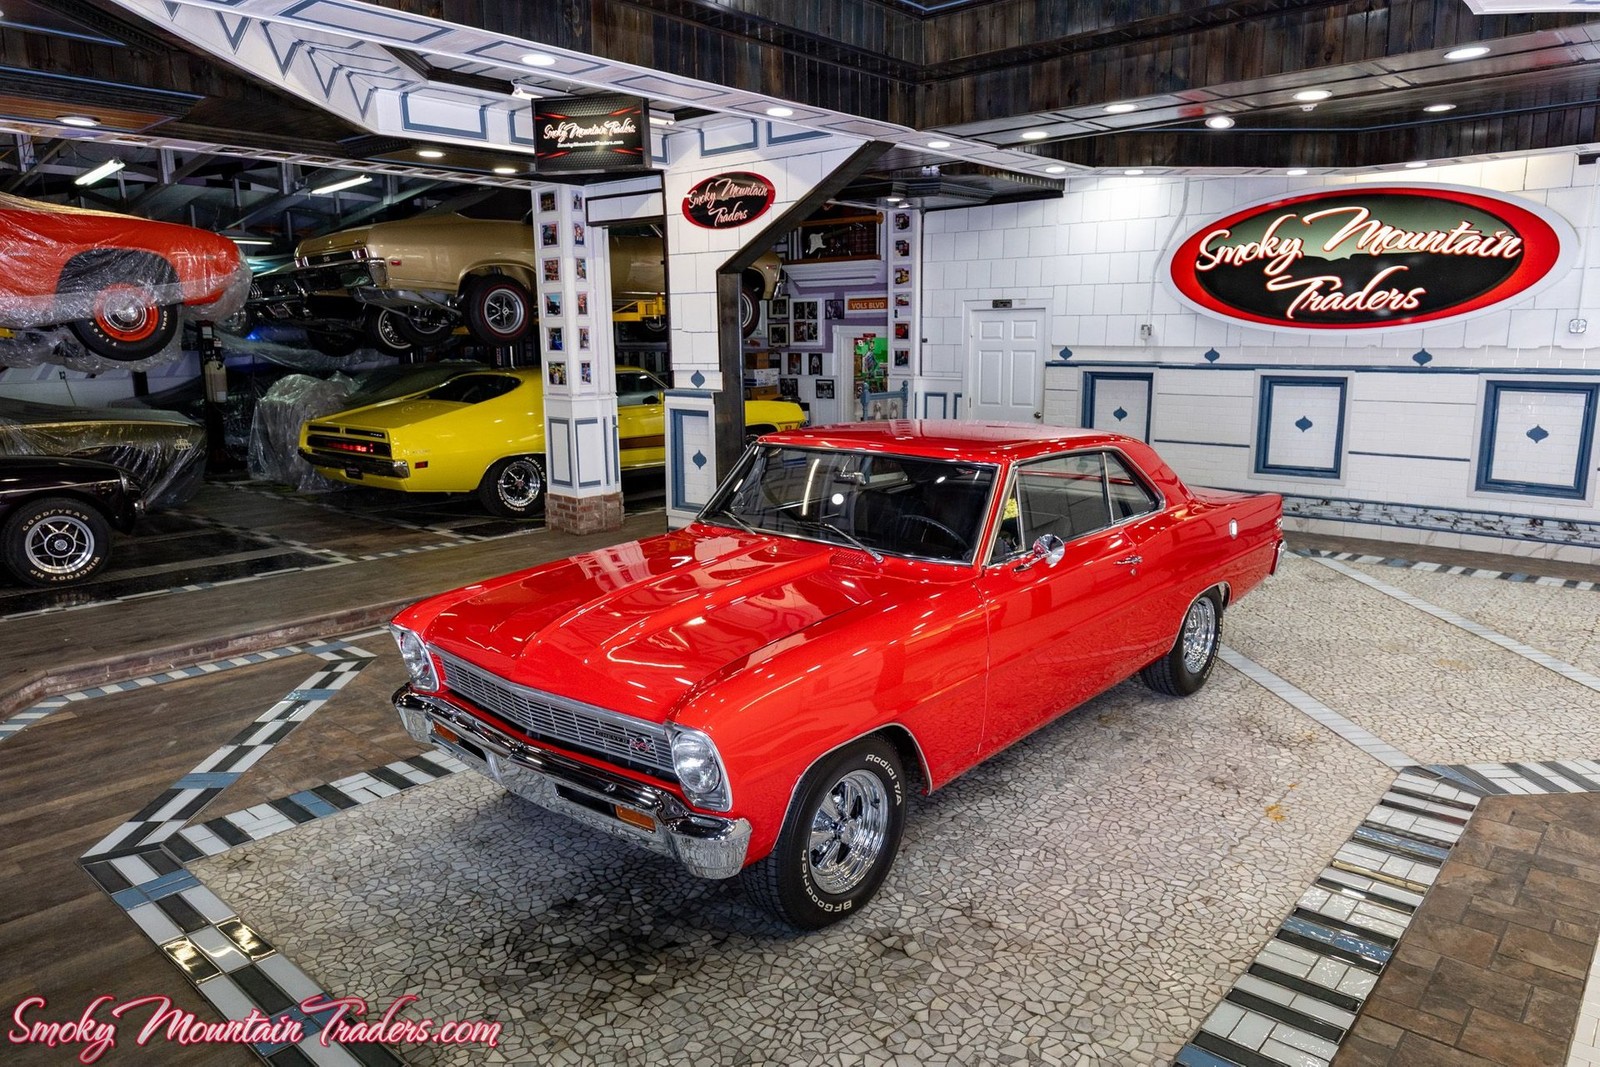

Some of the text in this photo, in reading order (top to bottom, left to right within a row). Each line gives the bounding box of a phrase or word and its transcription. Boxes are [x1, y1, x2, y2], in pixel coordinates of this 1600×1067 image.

[543, 117, 636, 142] Smoky Mountain Traders
[688, 178, 768, 209] Smoky Mountain
[708, 201, 748, 227] Traders
[1194, 206, 1522, 276] Smoky Mountain
[868, 301, 885, 309] BLVD
[1267, 265, 1426, 319] Traders
[22, 509, 89, 531] GOODYEAR
[30, 556, 101, 581] WINGFOOT HP
[865, 753, 902, 806] Radial T/A
[800, 849, 853, 913] BFGoodrich
